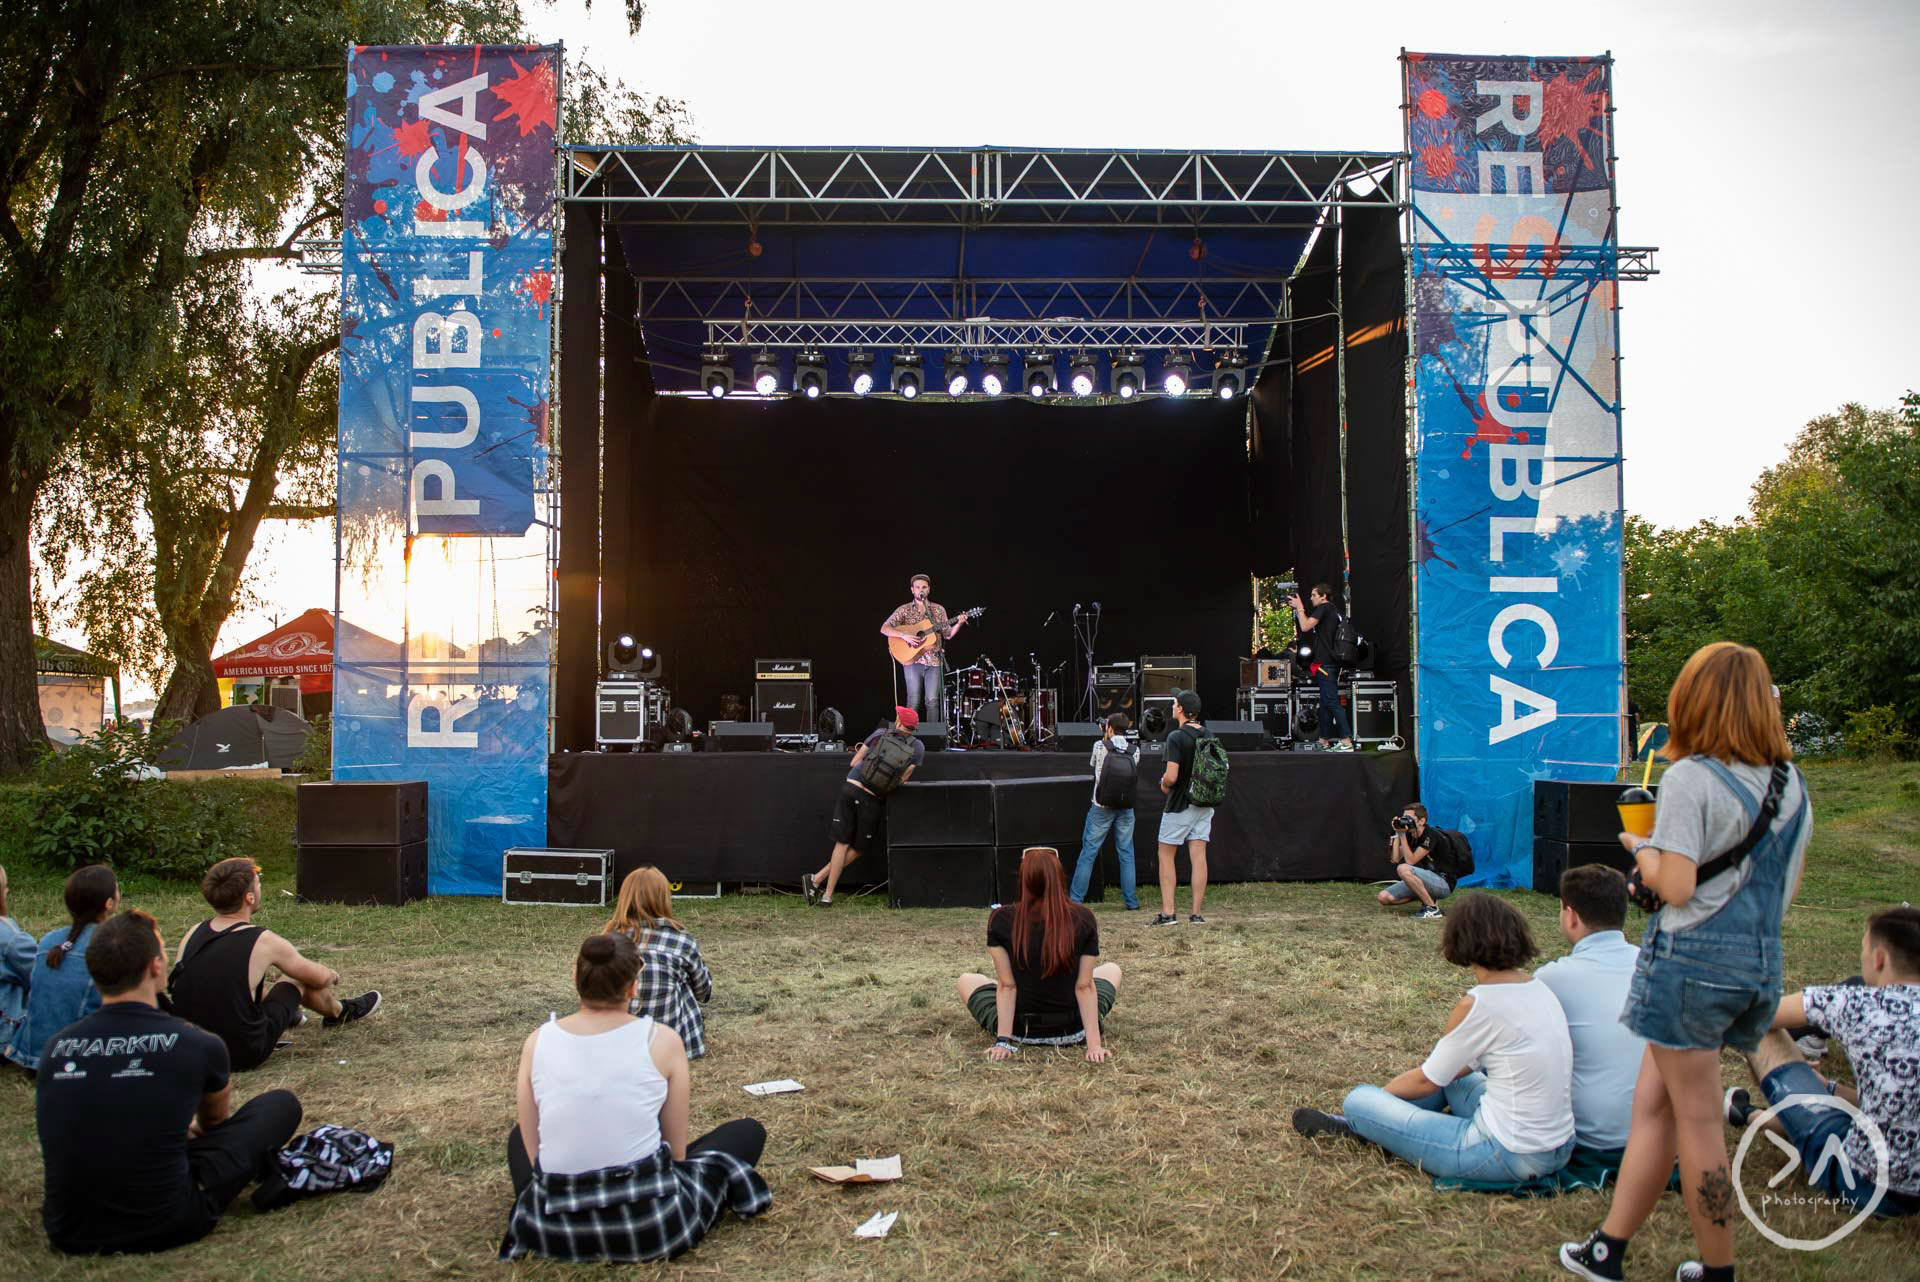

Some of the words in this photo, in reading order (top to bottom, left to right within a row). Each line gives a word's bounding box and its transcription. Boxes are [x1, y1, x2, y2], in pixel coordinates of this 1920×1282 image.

[223, 666, 265, 676] AMERICAN
[265, 665, 294, 675] LEGEND
[296, 664, 317, 673] SINCE
[320, 663, 335, 672] 187
[50, 1032, 180, 1058] KHARKIV
